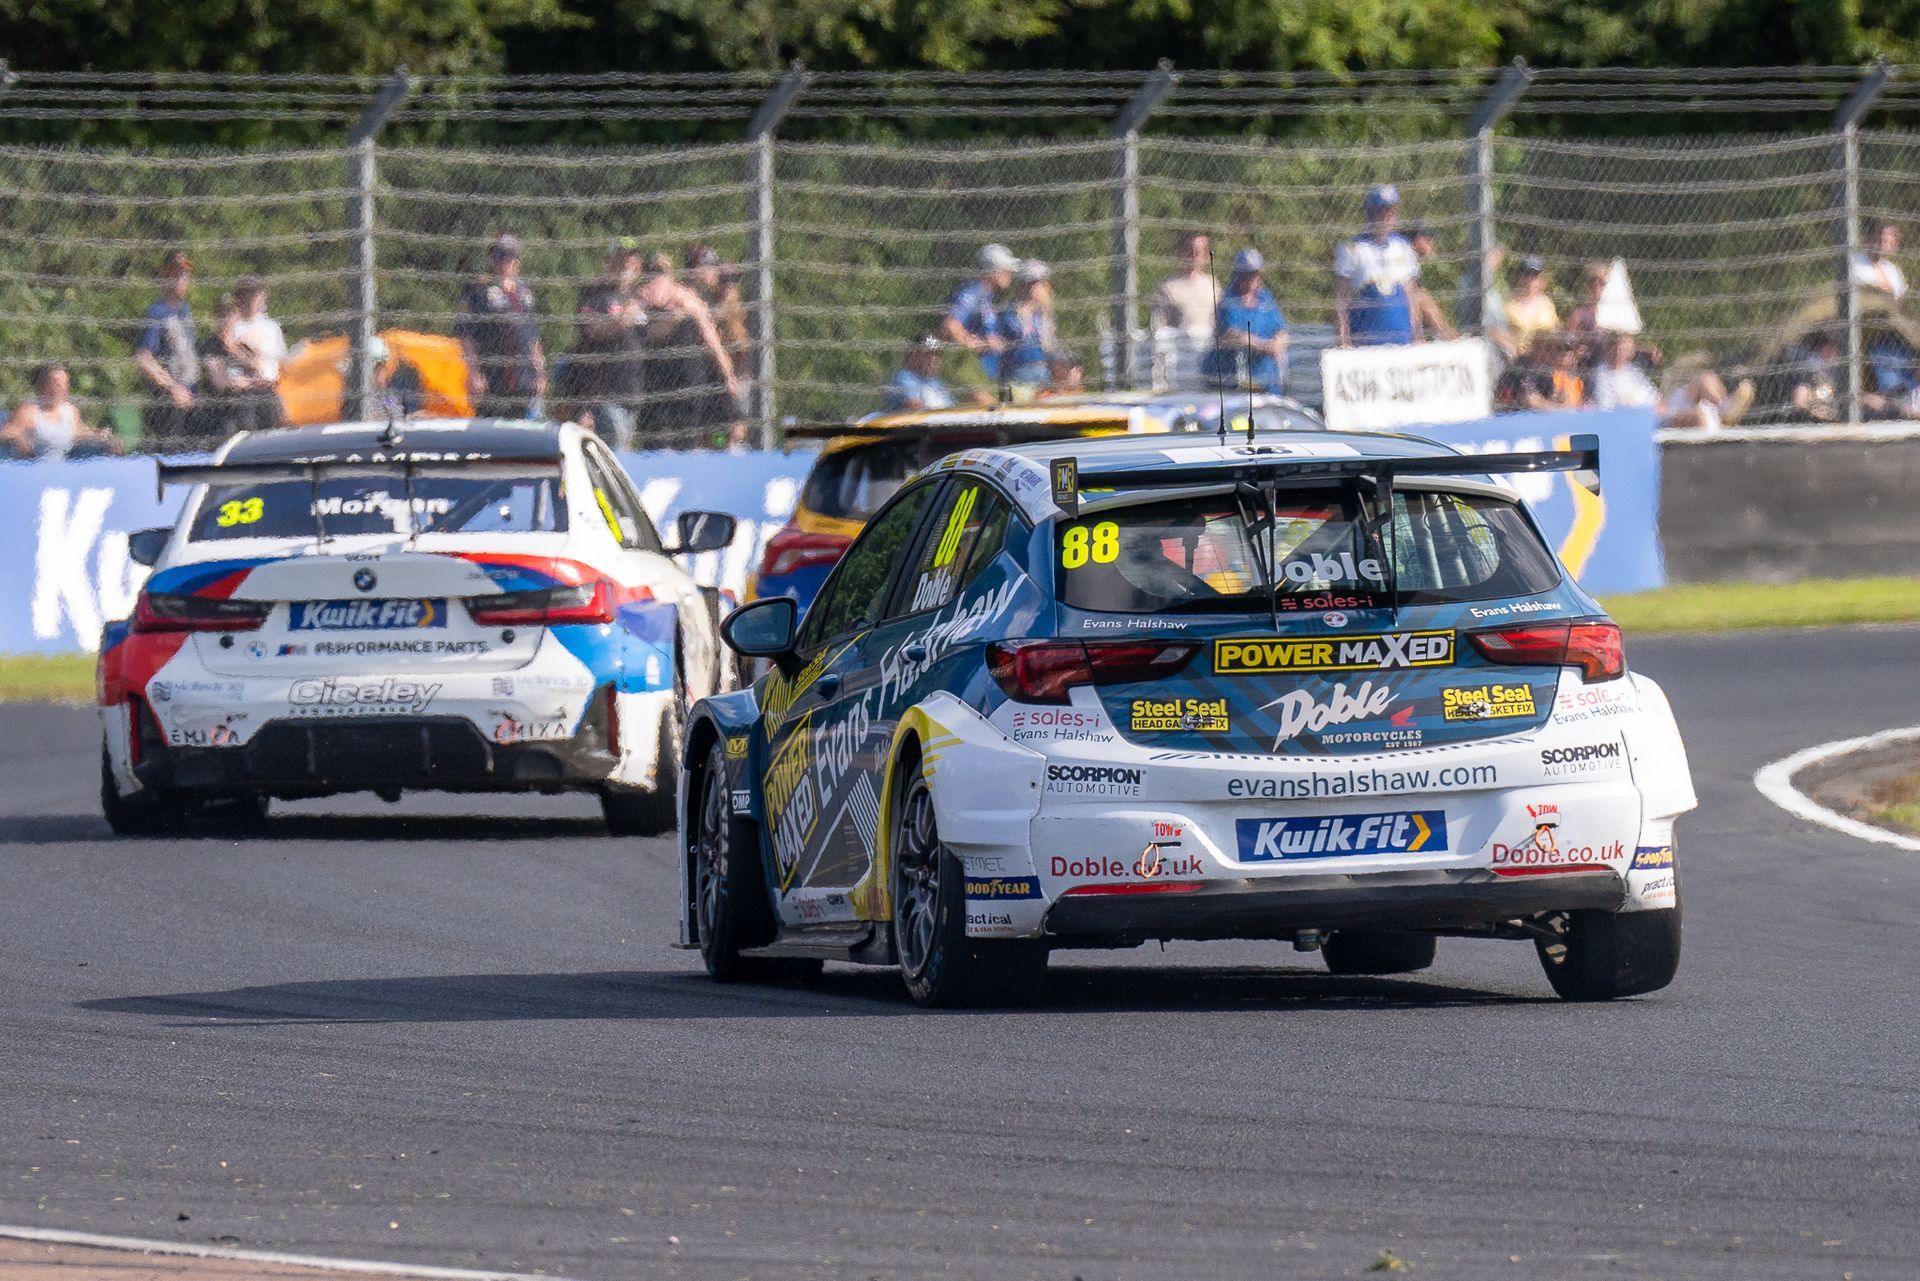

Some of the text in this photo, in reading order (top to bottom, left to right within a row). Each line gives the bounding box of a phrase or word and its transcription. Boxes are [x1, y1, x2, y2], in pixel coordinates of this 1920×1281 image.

[217, 497, 265, 527] 33
[934, 487, 979, 568] 88
[1062, 521, 1120, 569] 88
[911, 567, 952, 612] Doble
[1303, 594, 1373, 609] sales-i
[1470, 601, 1562, 618] Evans Halshaw
[1083, 618, 1189, 630] Evans Halshaw
[313, 639, 435, 655] PERFORMANCE
[436, 640, 489, 653] PARTS
[1220, 632, 1449, 669] POWER MAXED
[287, 678, 443, 713] Ciceley
[1443, 684, 1533, 706] Steel Seal
[1132, 698, 1228, 717] Steel Seal
[1256, 681, 1400, 752] Doble
[1030, 709, 1100, 727] sales-i
[1133, 719, 1163, 729] HEAD
[1553, 712, 1588, 725] Evans
[1013, 728, 1114, 743] Evans Halshaw
[1322, 730, 1422, 744] MOTORCYCLES
[815, 688, 873, 810] Evans
[1541, 743, 1620, 765] SCORPION
[1047, 765, 1141, 785] SCORPION
[1544, 759, 1622, 777] AUTOMOTIVE
[766, 728, 809, 829] POWER
[1227, 764, 1497, 798] evanshalshaw.com
[1047, 782, 1140, 796] AUTOMOTIVE
[732, 794, 750, 810] OMP
[1537, 804, 1558, 815] TOW
[774, 774, 813, 876] MAXED
[1154, 823, 1174, 837] TOW
[1492, 840, 1625, 864] Doble.co.uk
[1051, 855, 1204, 879] Doble.co.uk
